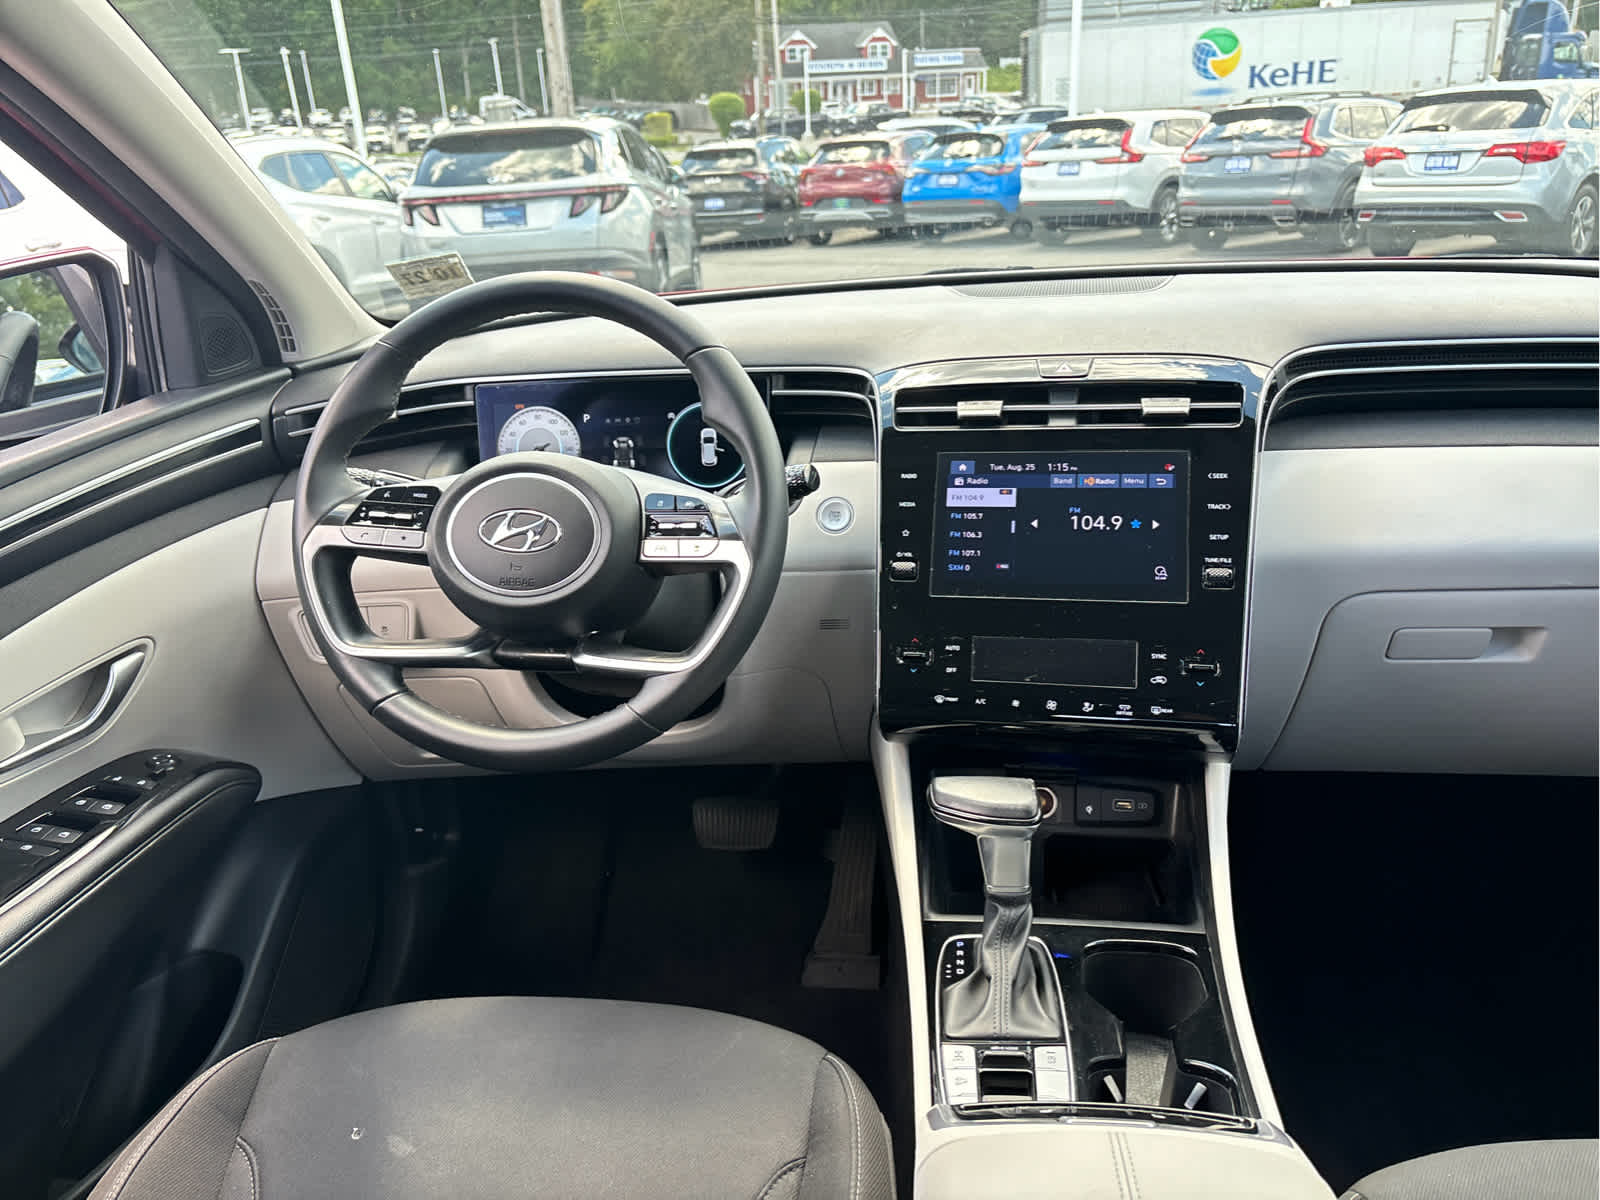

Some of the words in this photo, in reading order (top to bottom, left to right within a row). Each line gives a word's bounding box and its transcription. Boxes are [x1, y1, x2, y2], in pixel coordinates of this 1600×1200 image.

[1248, 58, 1338, 88] KeHE
[583, 414, 590, 423] P
[990, 463, 1006, 471] Tue.
[1007, 464, 1023, 472] Aug.
[1025, 463, 1036, 471] 25
[1047, 463, 1069, 471] 1:15
[967, 477, 989, 485] Radio
[1053, 477, 1073, 485] Band
[1124, 477, 1144, 485] Menu
[1070, 515, 1123, 530] 104.9
[961, 549, 981, 557] 107.1
[499, 576, 536, 587] AIRBAG
